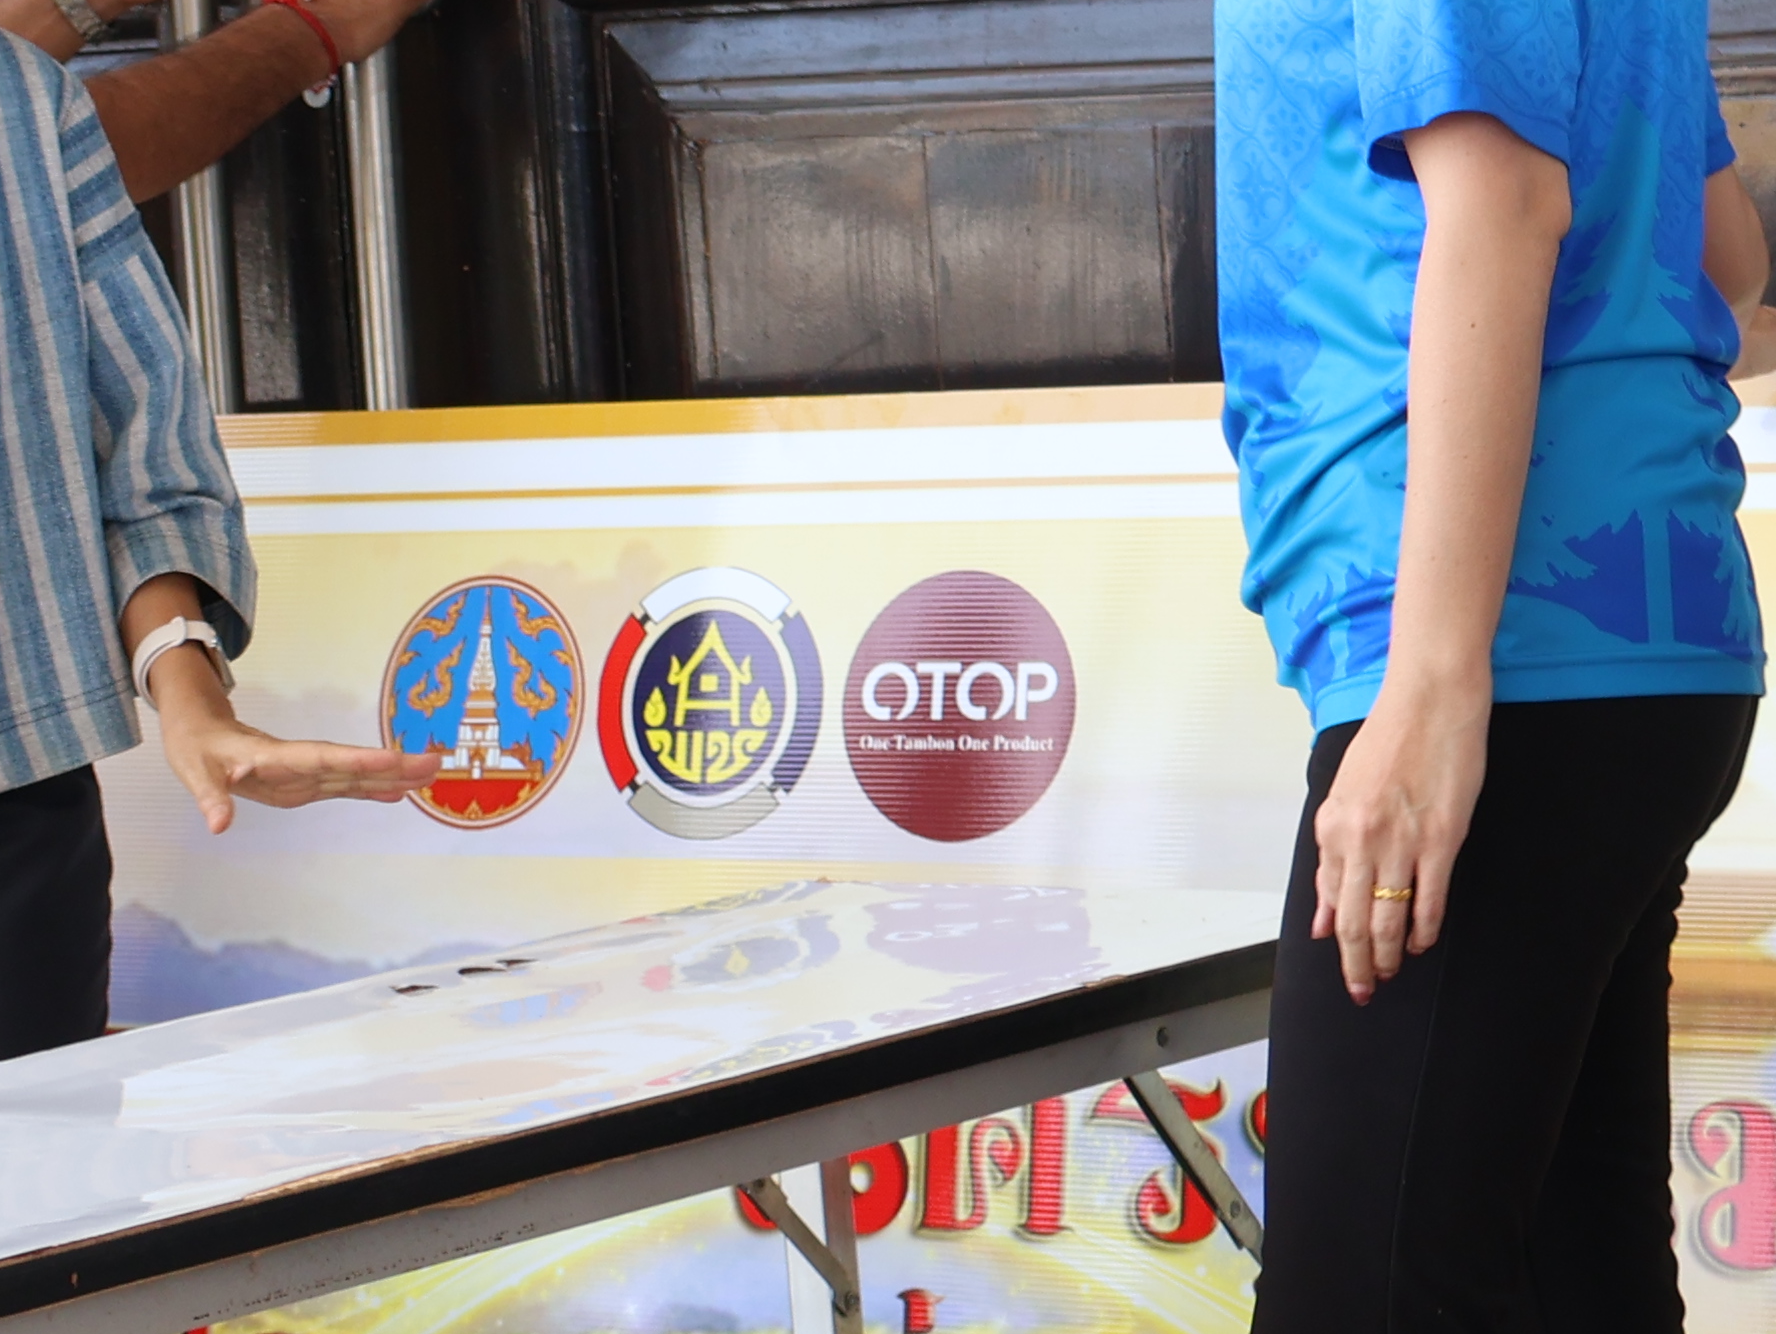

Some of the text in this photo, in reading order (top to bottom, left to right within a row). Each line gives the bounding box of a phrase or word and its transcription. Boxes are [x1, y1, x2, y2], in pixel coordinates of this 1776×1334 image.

[861, 661, 1060, 722] OTOP
[859, 734, 1055, 753] One Tambon One Product
